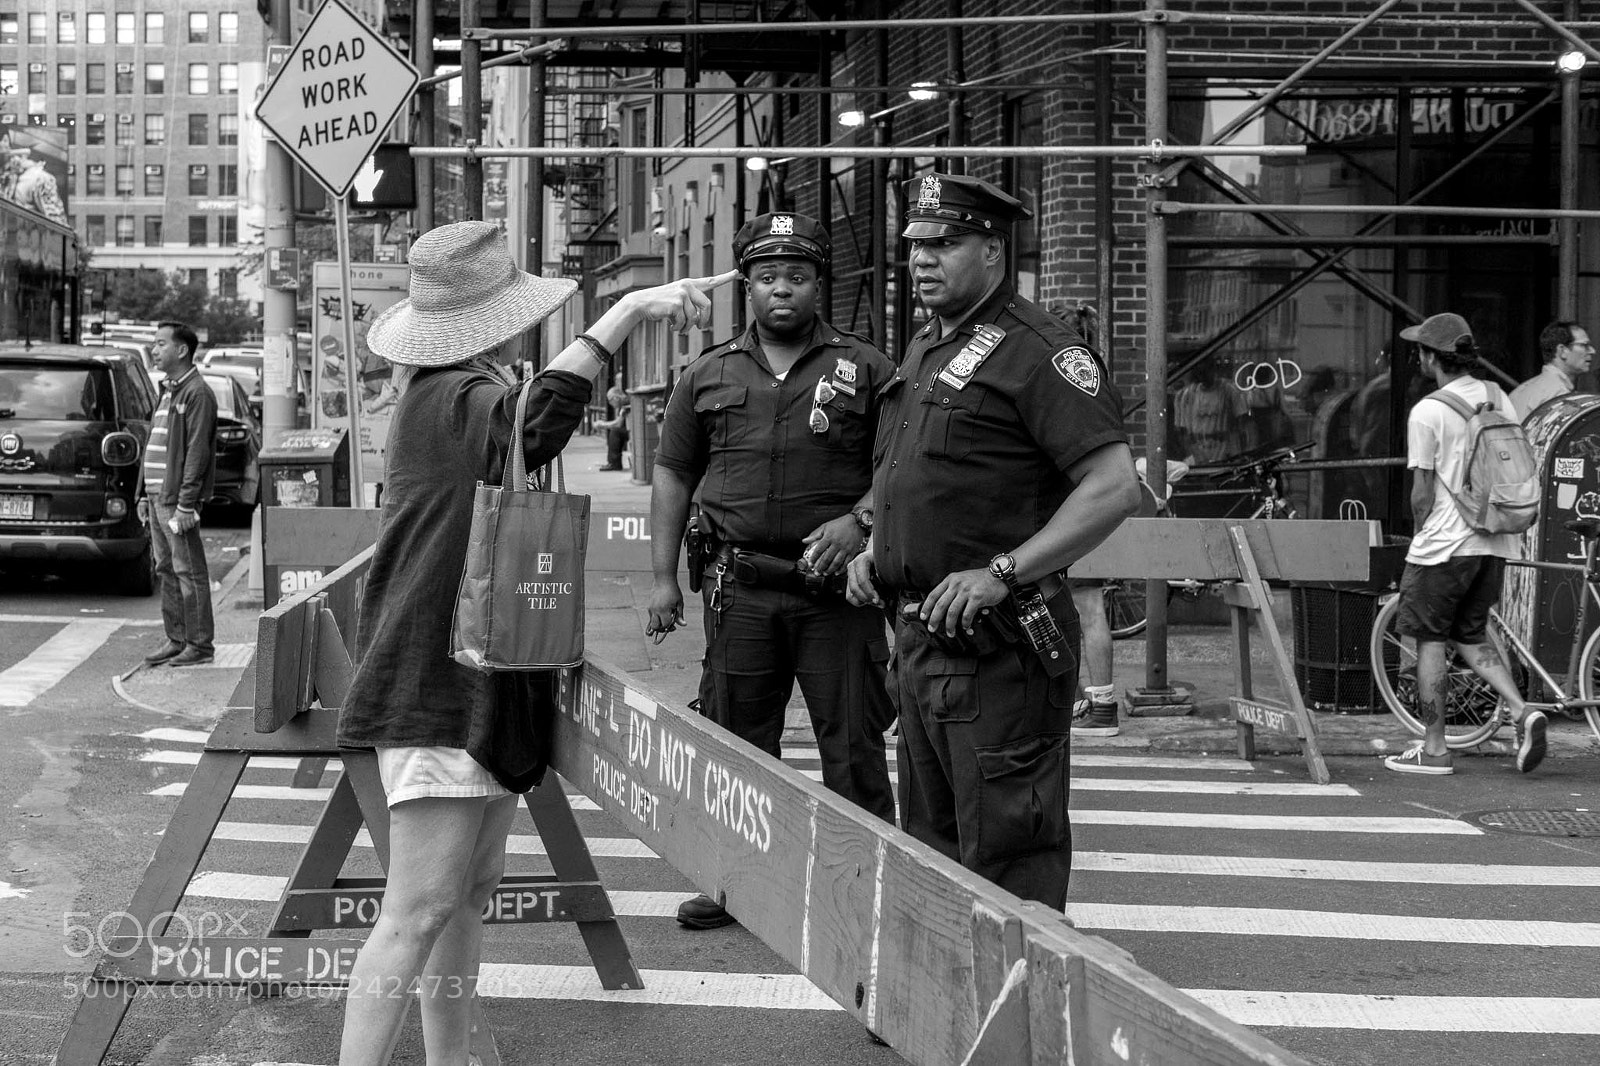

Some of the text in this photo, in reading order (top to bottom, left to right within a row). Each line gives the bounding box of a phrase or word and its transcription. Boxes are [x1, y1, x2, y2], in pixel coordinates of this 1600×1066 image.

[302, 37, 365, 72] ROAD
[302, 73, 368, 109] WORK
[298, 111, 377, 149] AHEAD
[350, 269, 383, 279] hone
[1235, 358, 1301, 391] GOD
[515, 582, 572, 595] ARTISTIC
[527, 597, 557, 610] TILE
[1237, 702, 1264, 726] POLICE
[573, 676, 602, 737] LINE
[629, 710, 652, 769] DO
[659, 728, 697, 800] NOT
[704, 760, 772, 852] CROSS
[593, 753, 627, 807] POLICE
[151, 945, 362, 979] POLICE DE
